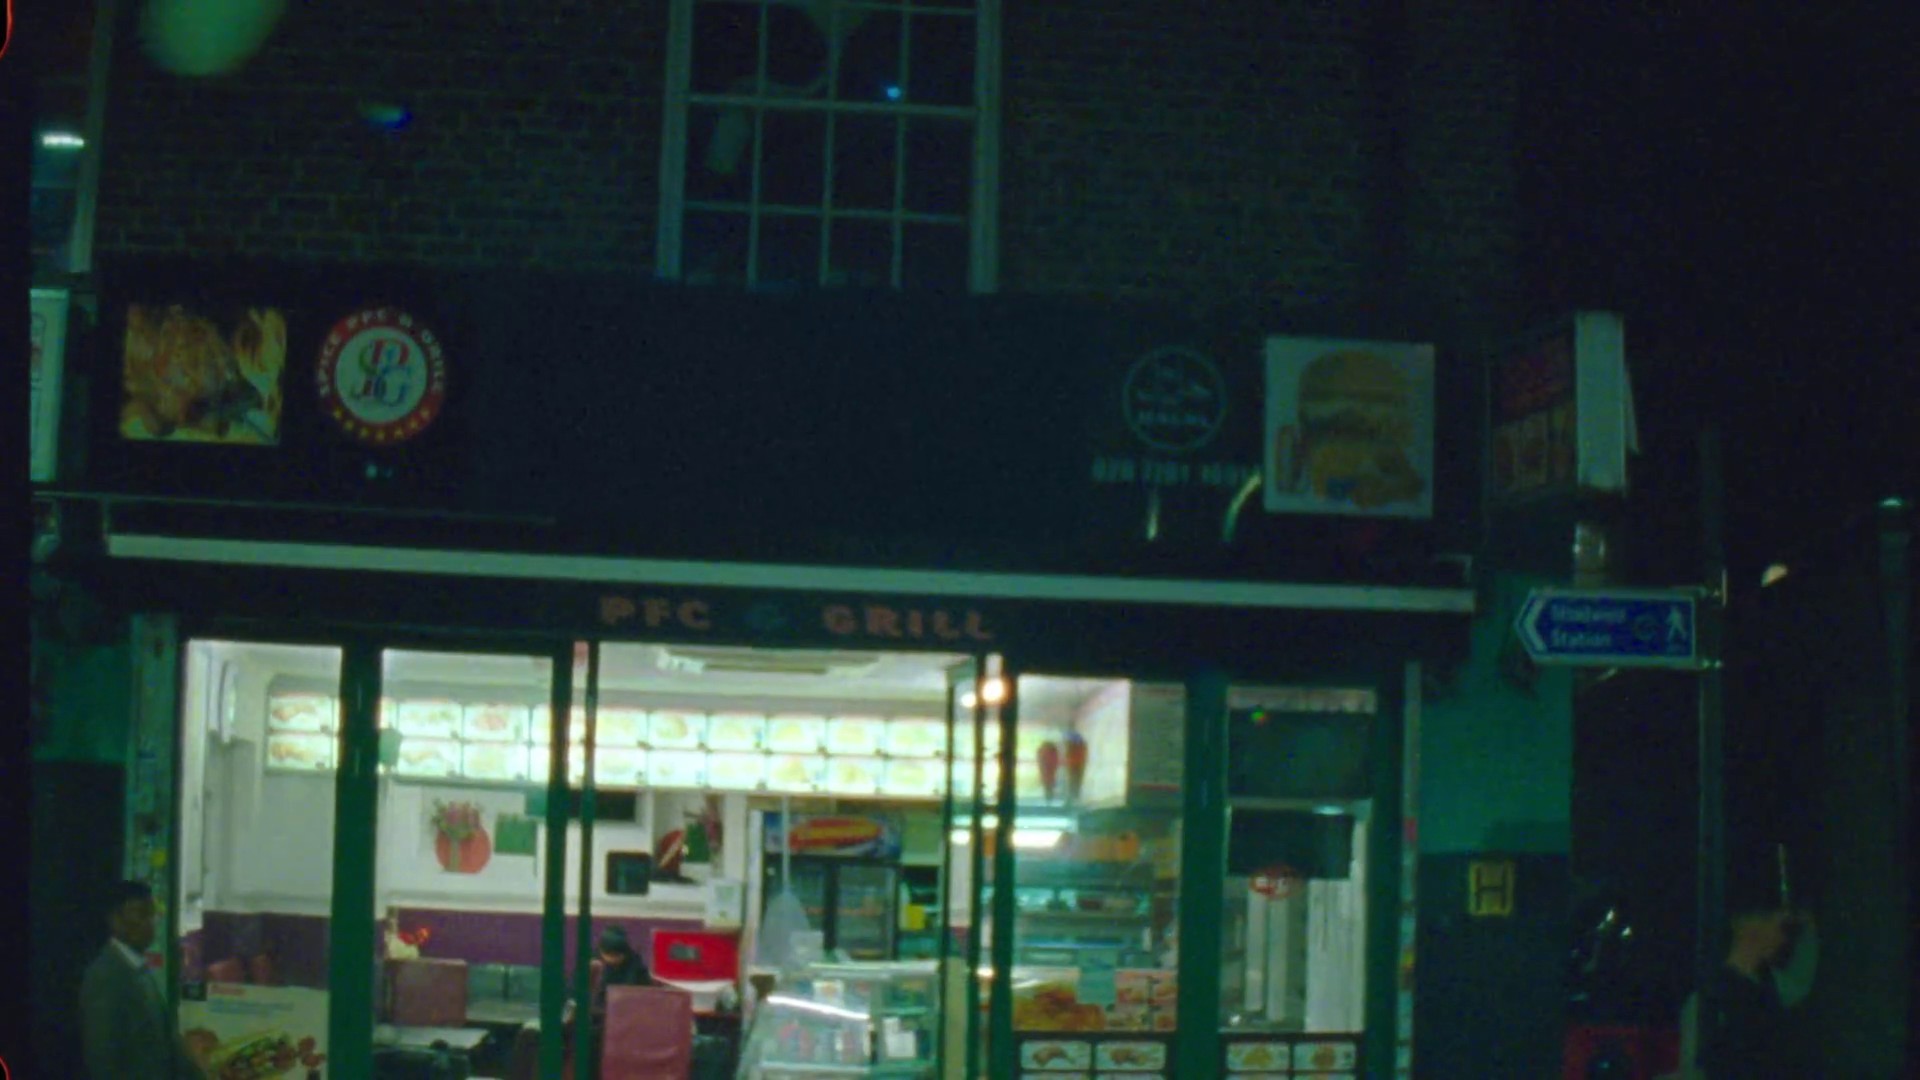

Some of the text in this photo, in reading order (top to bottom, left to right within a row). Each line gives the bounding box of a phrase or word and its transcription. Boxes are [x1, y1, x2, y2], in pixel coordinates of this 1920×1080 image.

[598, 595, 711, 630] PFC
[822, 603, 993, 640] GRILL
[1550, 627, 1612, 648] Station
[1475, 865, 1507, 911] H
